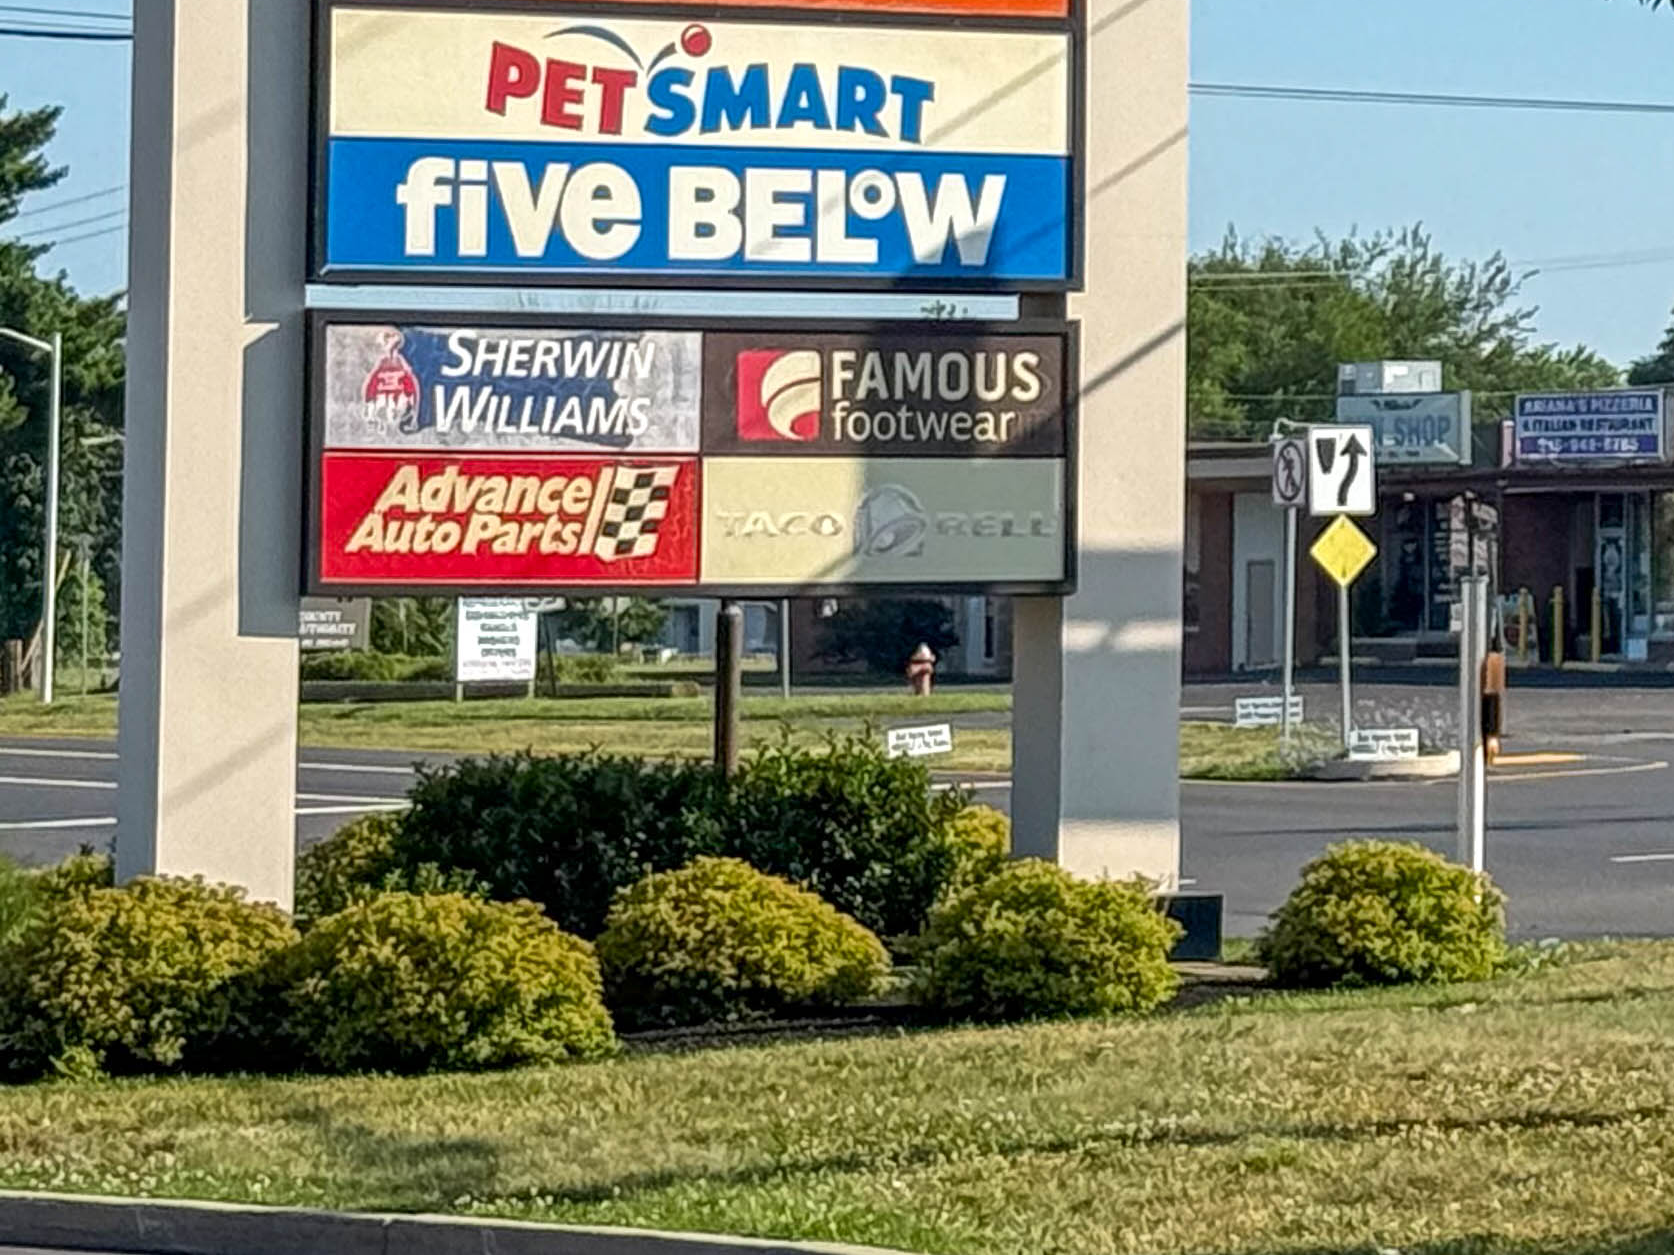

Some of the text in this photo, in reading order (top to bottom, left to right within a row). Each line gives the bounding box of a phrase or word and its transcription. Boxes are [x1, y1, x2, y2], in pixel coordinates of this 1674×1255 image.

[396, 156, 643, 260] five
[441, 330, 656, 380] SHERWIN
[832, 350, 1041, 401] FAMOUS
[433, 384, 652, 435] WILLIAMS
[831, 401, 1016, 442] footwear
[375, 465, 592, 515] Advance
[344, 510, 583, 555] Auto Parts
